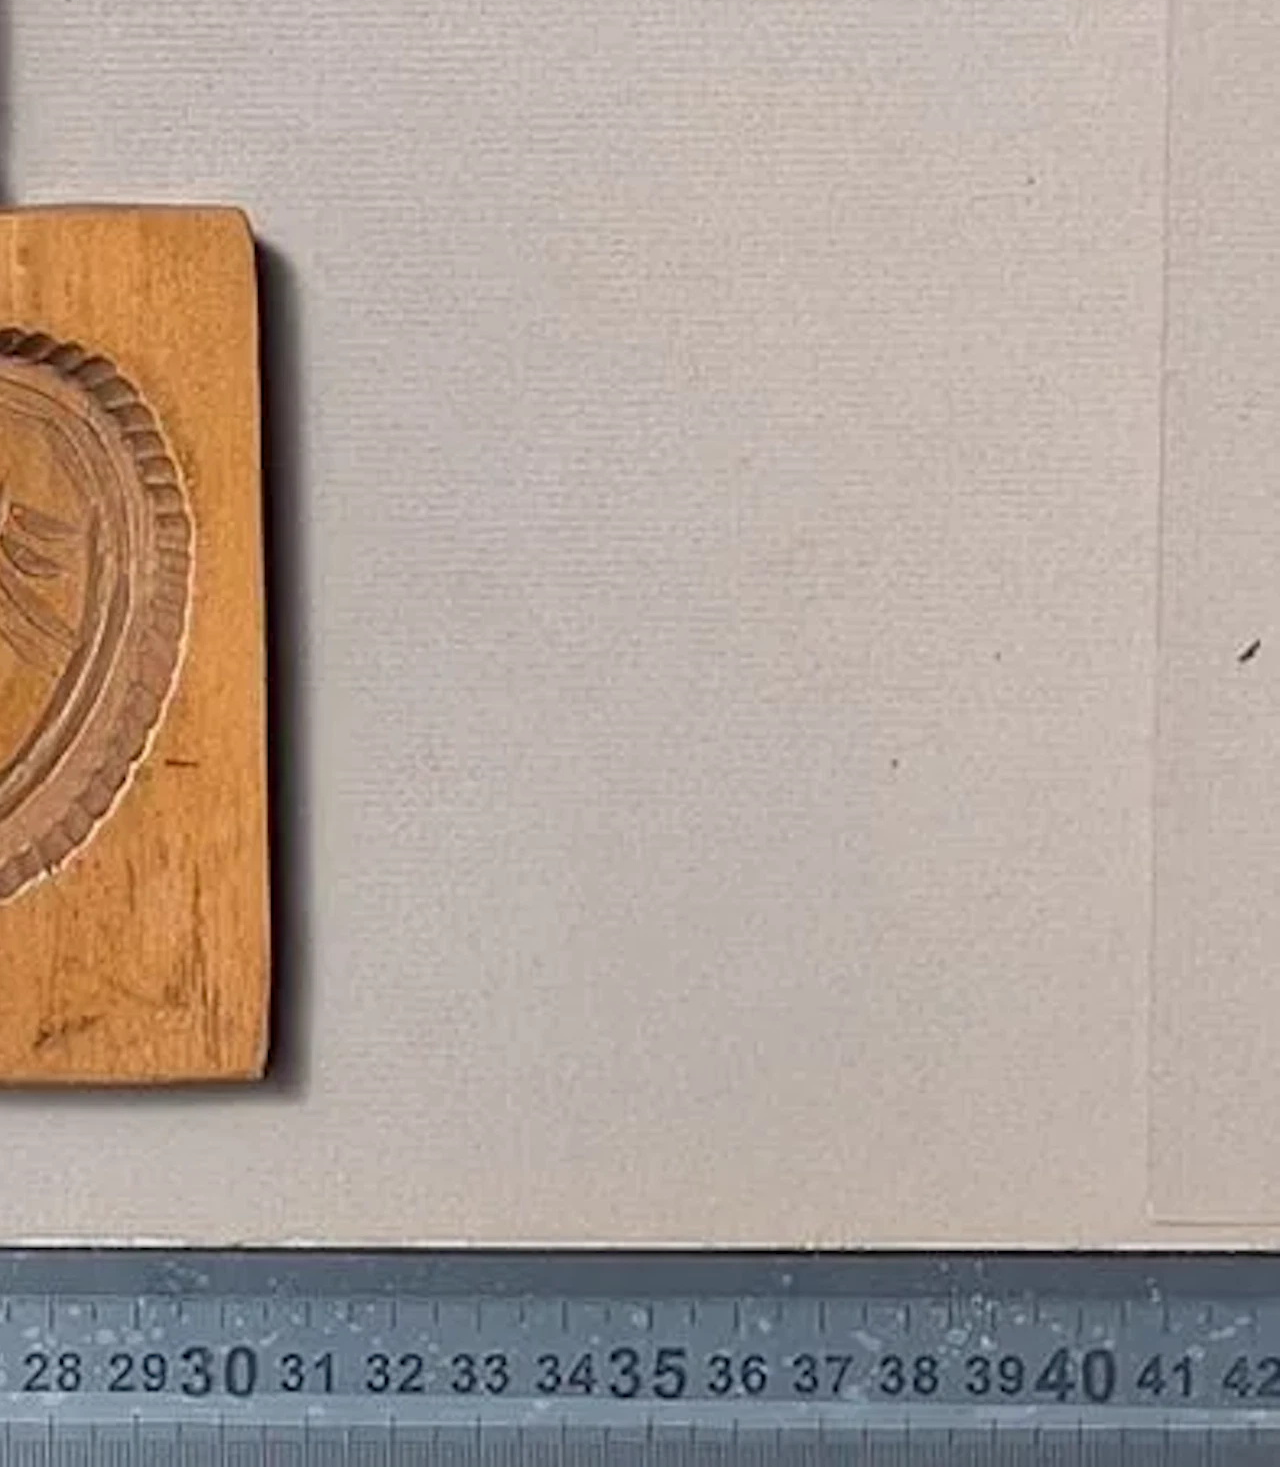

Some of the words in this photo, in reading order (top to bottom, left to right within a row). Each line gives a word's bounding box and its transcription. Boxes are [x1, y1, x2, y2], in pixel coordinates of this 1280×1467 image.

[22, 1351, 82, 1392] 28
[109, 1352, 167, 1392] 29
[181, 1346, 256, 1398] 30
[276, 1353, 332, 1394] 31
[367, 1353, 424, 1394] 32
[451, 1354, 509, 1395] 33
[537, 1353, 596, 1396] 34
[609, 1347, 685, 1400] 35
[709, 1355, 766, 1398] 36
[794, 1354, 852, 1394] 37
[880, 1355, 938, 1397] 38
[966, 1355, 1023, 1396] 39
[1037, 1348, 1114, 1404] 40
[1138, 1356, 1190, 1398] 41
[1224, 1357, 1280, 1398] 42
